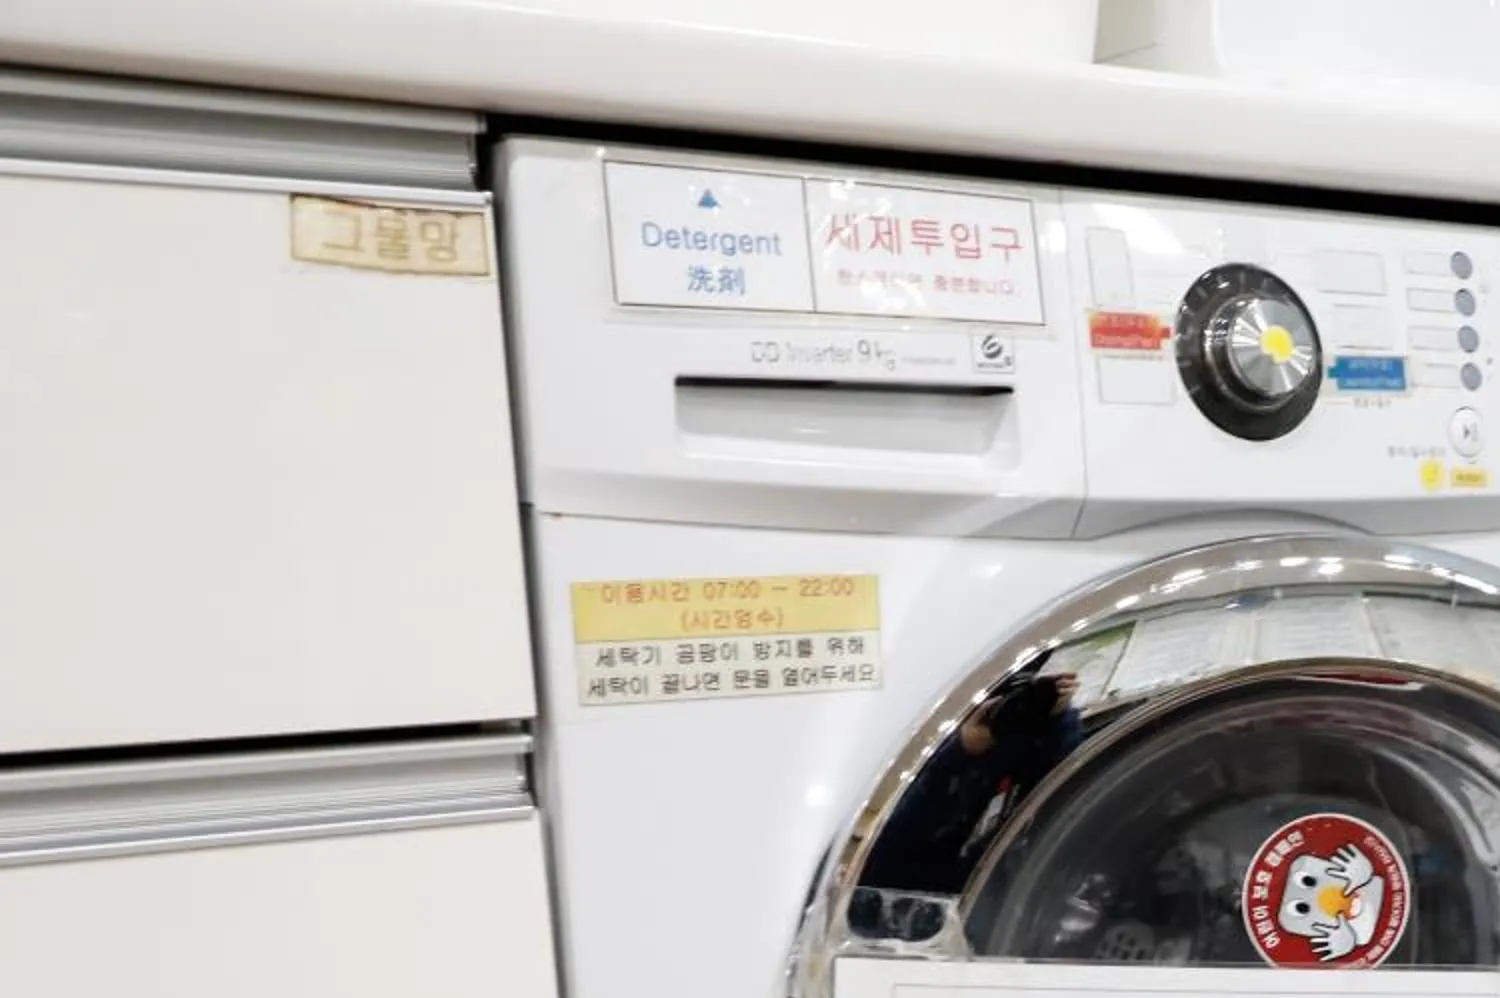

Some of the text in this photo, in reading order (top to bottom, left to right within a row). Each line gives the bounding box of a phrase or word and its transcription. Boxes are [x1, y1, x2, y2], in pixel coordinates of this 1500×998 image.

[641, 220, 782, 257] Detergent
[825, 212, 1025, 261] 세제투입구
[602, 583, 690, 604] 이용시간
[703, 580, 761, 599] 07:00
[800, 577, 855, 597] 22:00
[596, 646, 661, 668] 세탁기
[677, 643, 738, 664] 곰팡이
[753, 639, 814, 660] 방지를
[588, 664, 875, 698] 세탁이 끝나면 문을 열어두세요
